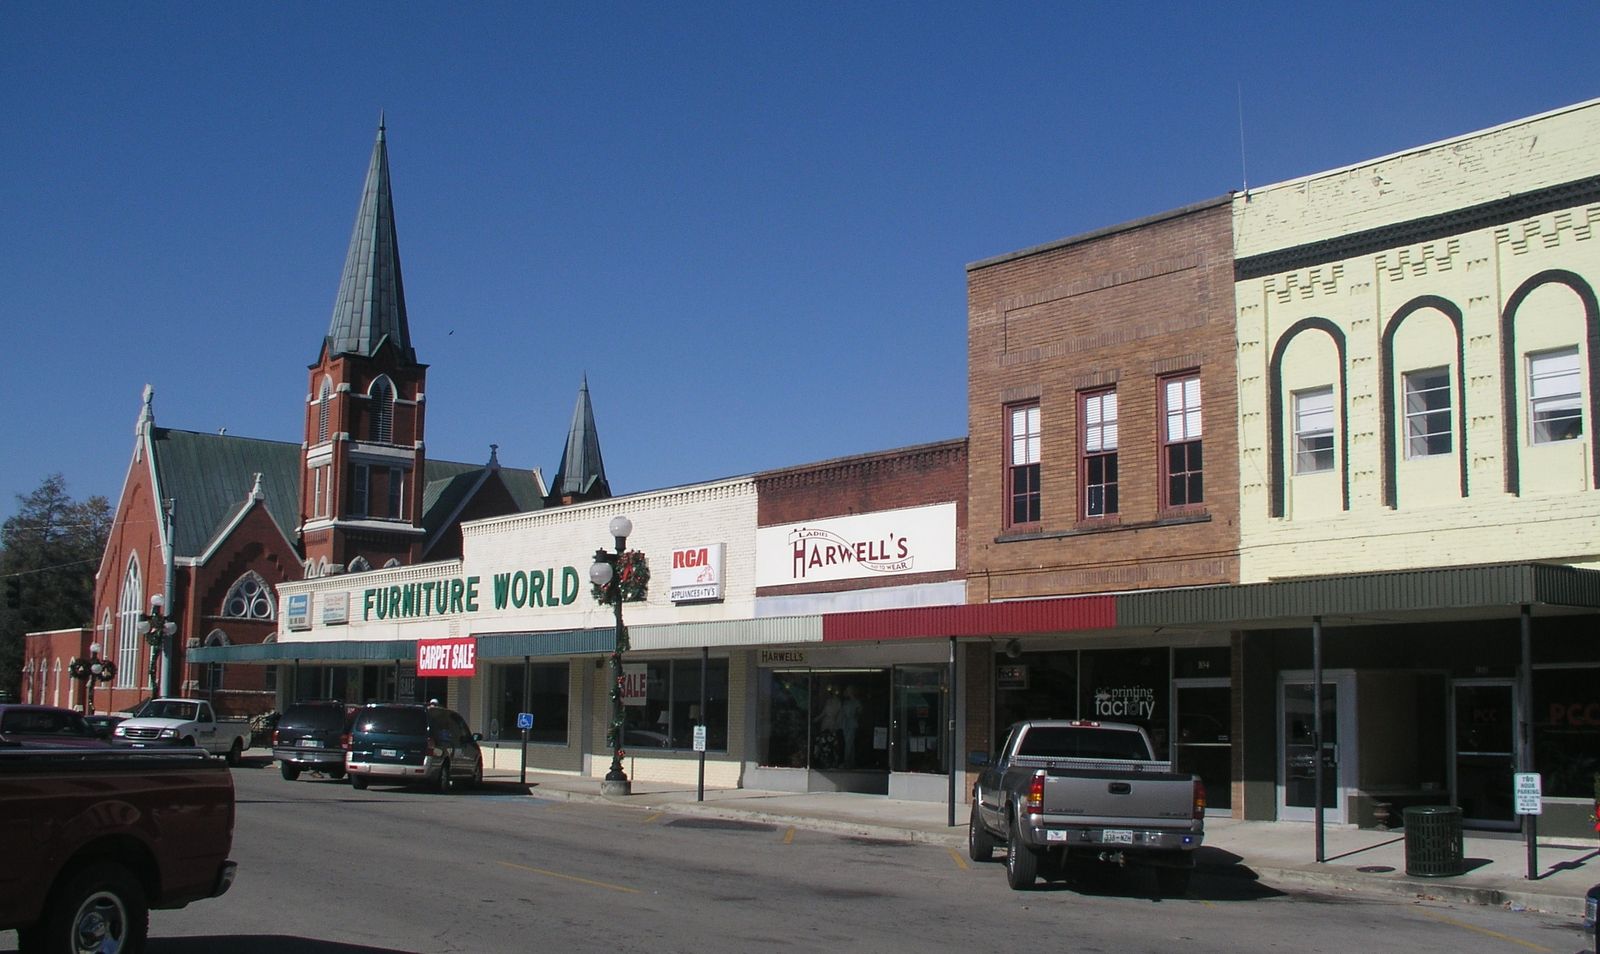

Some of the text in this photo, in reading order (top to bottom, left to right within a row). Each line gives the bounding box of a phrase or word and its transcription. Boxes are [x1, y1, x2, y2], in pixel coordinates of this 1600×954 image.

[673, 548, 708, 569] RCA
[793, 527, 908, 579] HARWELL'S
[364, 566, 580, 621] FURNITURE WORLD
[671, 589, 700, 599] APPLIANCES
[420, 644, 475, 669] CARPET SALE
[1112, 684, 1154, 702] printing
[1095, 697, 1156, 720] factory
